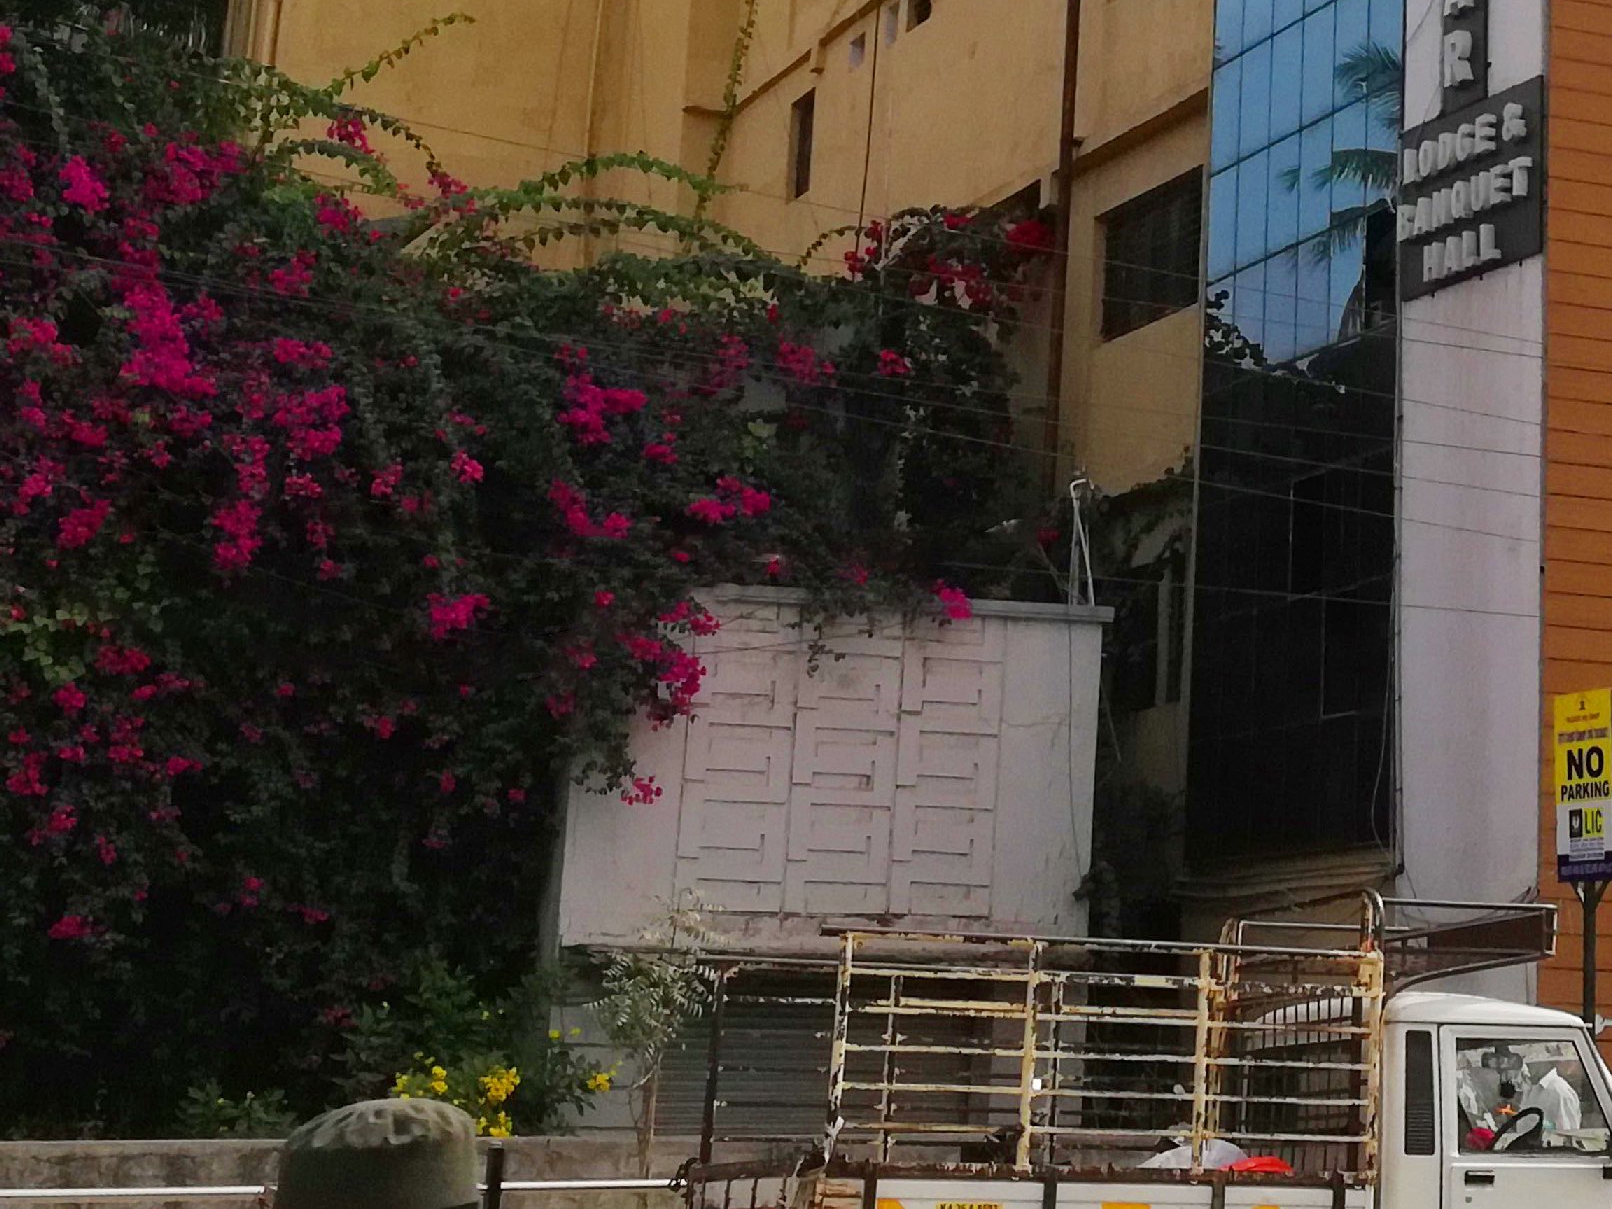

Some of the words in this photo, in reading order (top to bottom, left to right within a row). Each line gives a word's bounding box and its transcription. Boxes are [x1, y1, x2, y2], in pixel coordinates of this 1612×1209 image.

[1402, 113, 1497, 185] LODGE
[1502, 102, 1527, 141] &
[1397, 156, 1533, 242] BANQUET
[1423, 223, 1502, 282] HALL
[1566, 746, 1604, 781] NO
[1560, 780, 1610, 801] PARKING
[1584, 808, 1603, 834] LIC
